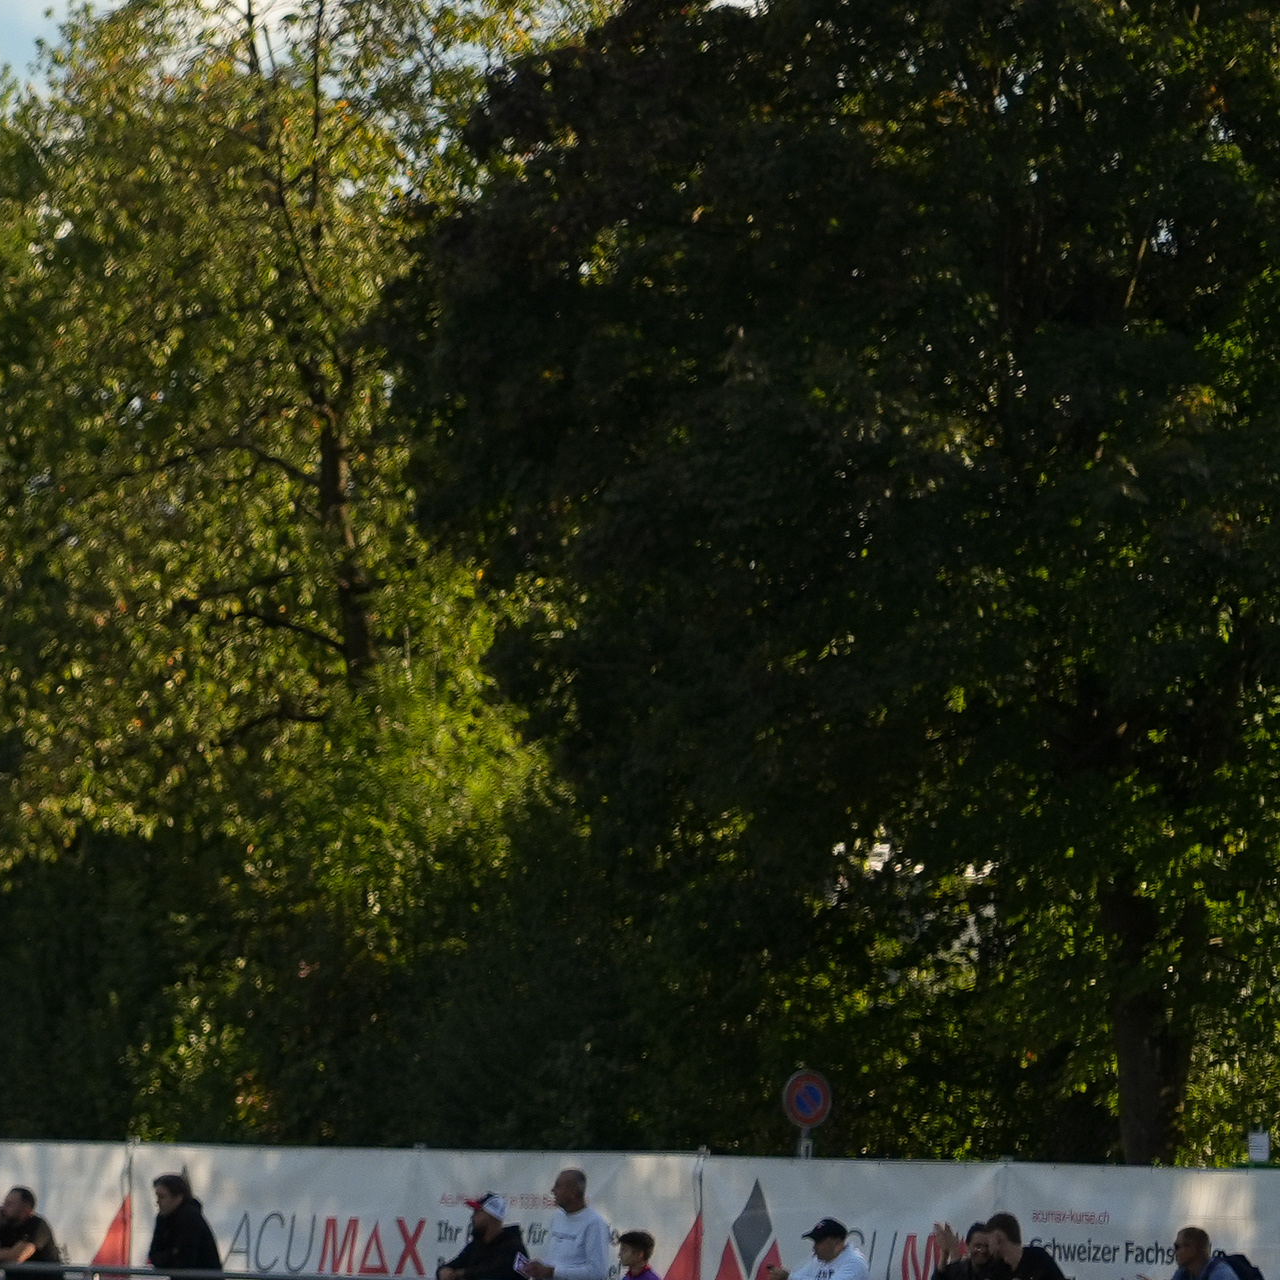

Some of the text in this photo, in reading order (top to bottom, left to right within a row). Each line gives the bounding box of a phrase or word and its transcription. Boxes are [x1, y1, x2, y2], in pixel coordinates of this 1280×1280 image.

[437, 1219, 463, 1244] Ihr
[526, 1222, 550, 1245] für
[222, 1212, 426, 1277] ACUMAX
